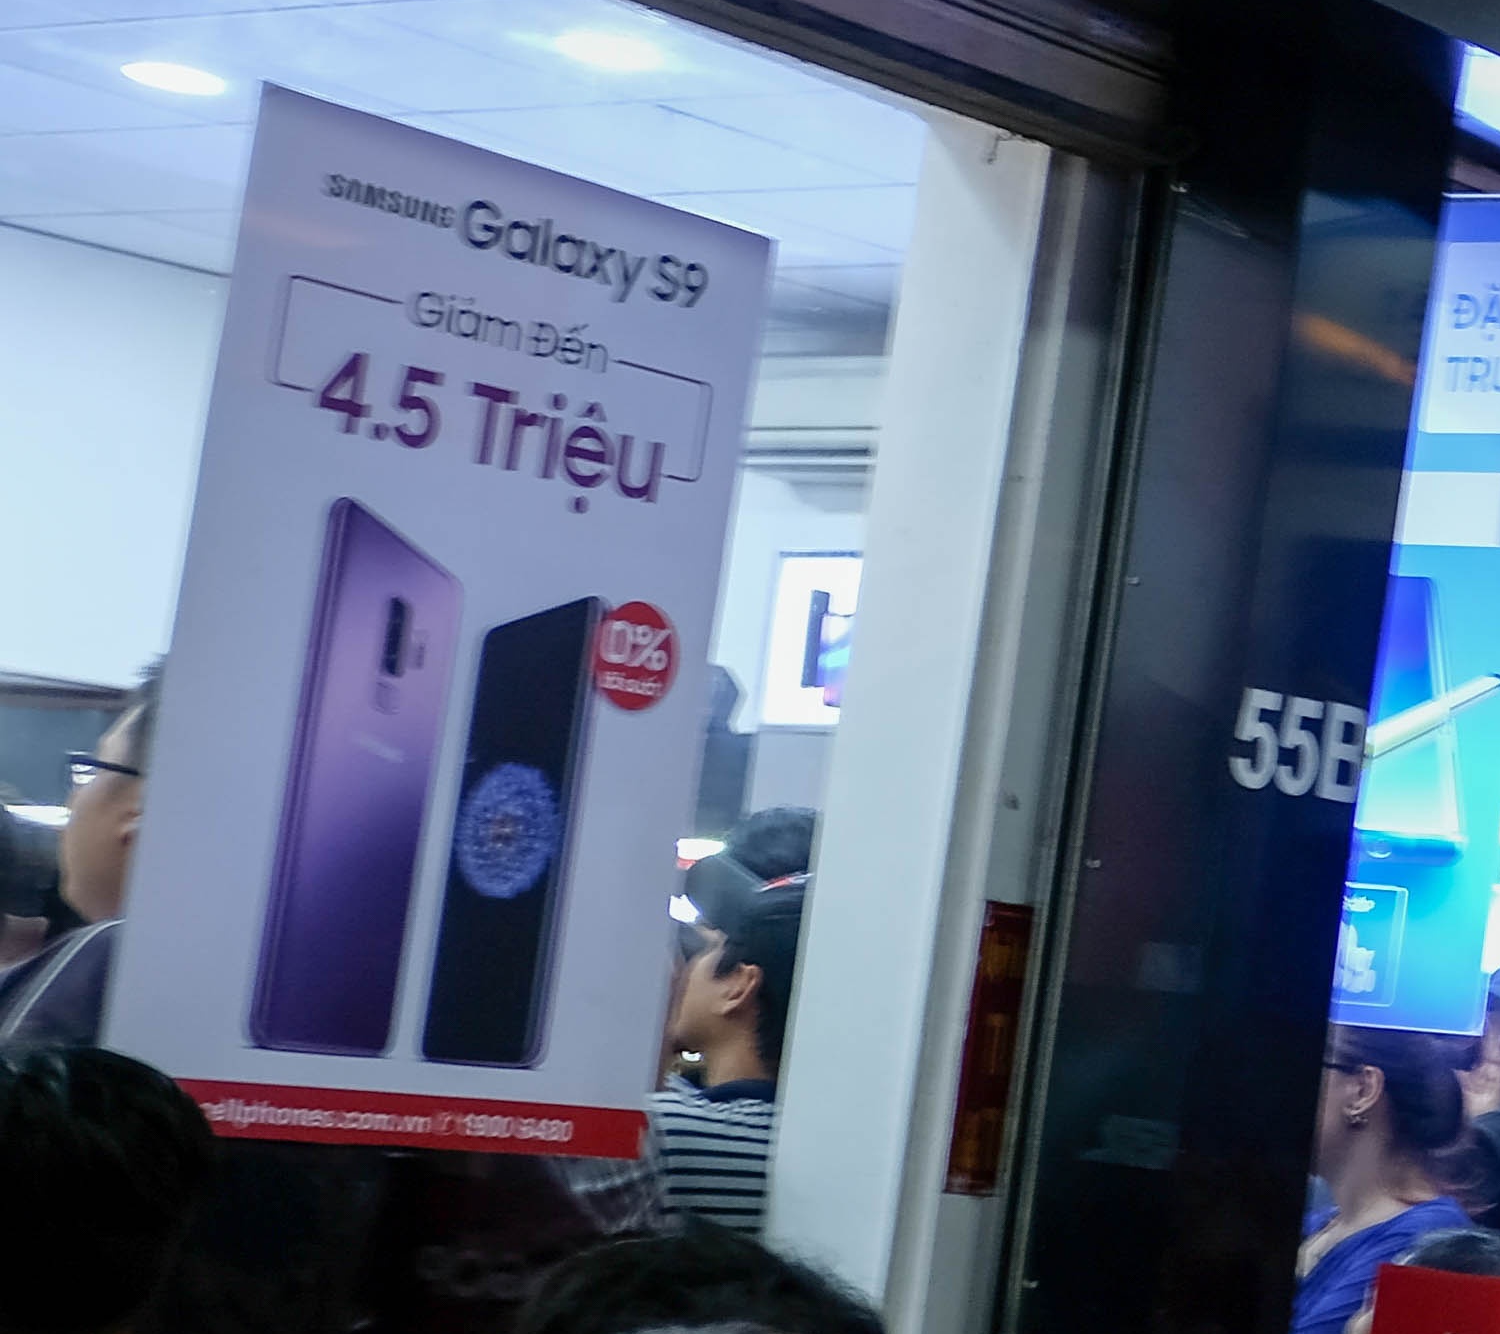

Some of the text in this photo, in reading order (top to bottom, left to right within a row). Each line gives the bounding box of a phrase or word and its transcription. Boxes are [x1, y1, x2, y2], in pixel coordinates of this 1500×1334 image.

[459, 199, 648, 304] Galaxy
[652, 253, 710, 308] S9
[409, 289, 610, 374] Giảm Đến
[316, 352, 667, 512] 4.5 Triệu
[600, 620, 672, 671] 0%
[1229, 689, 1368, 803] 55B
